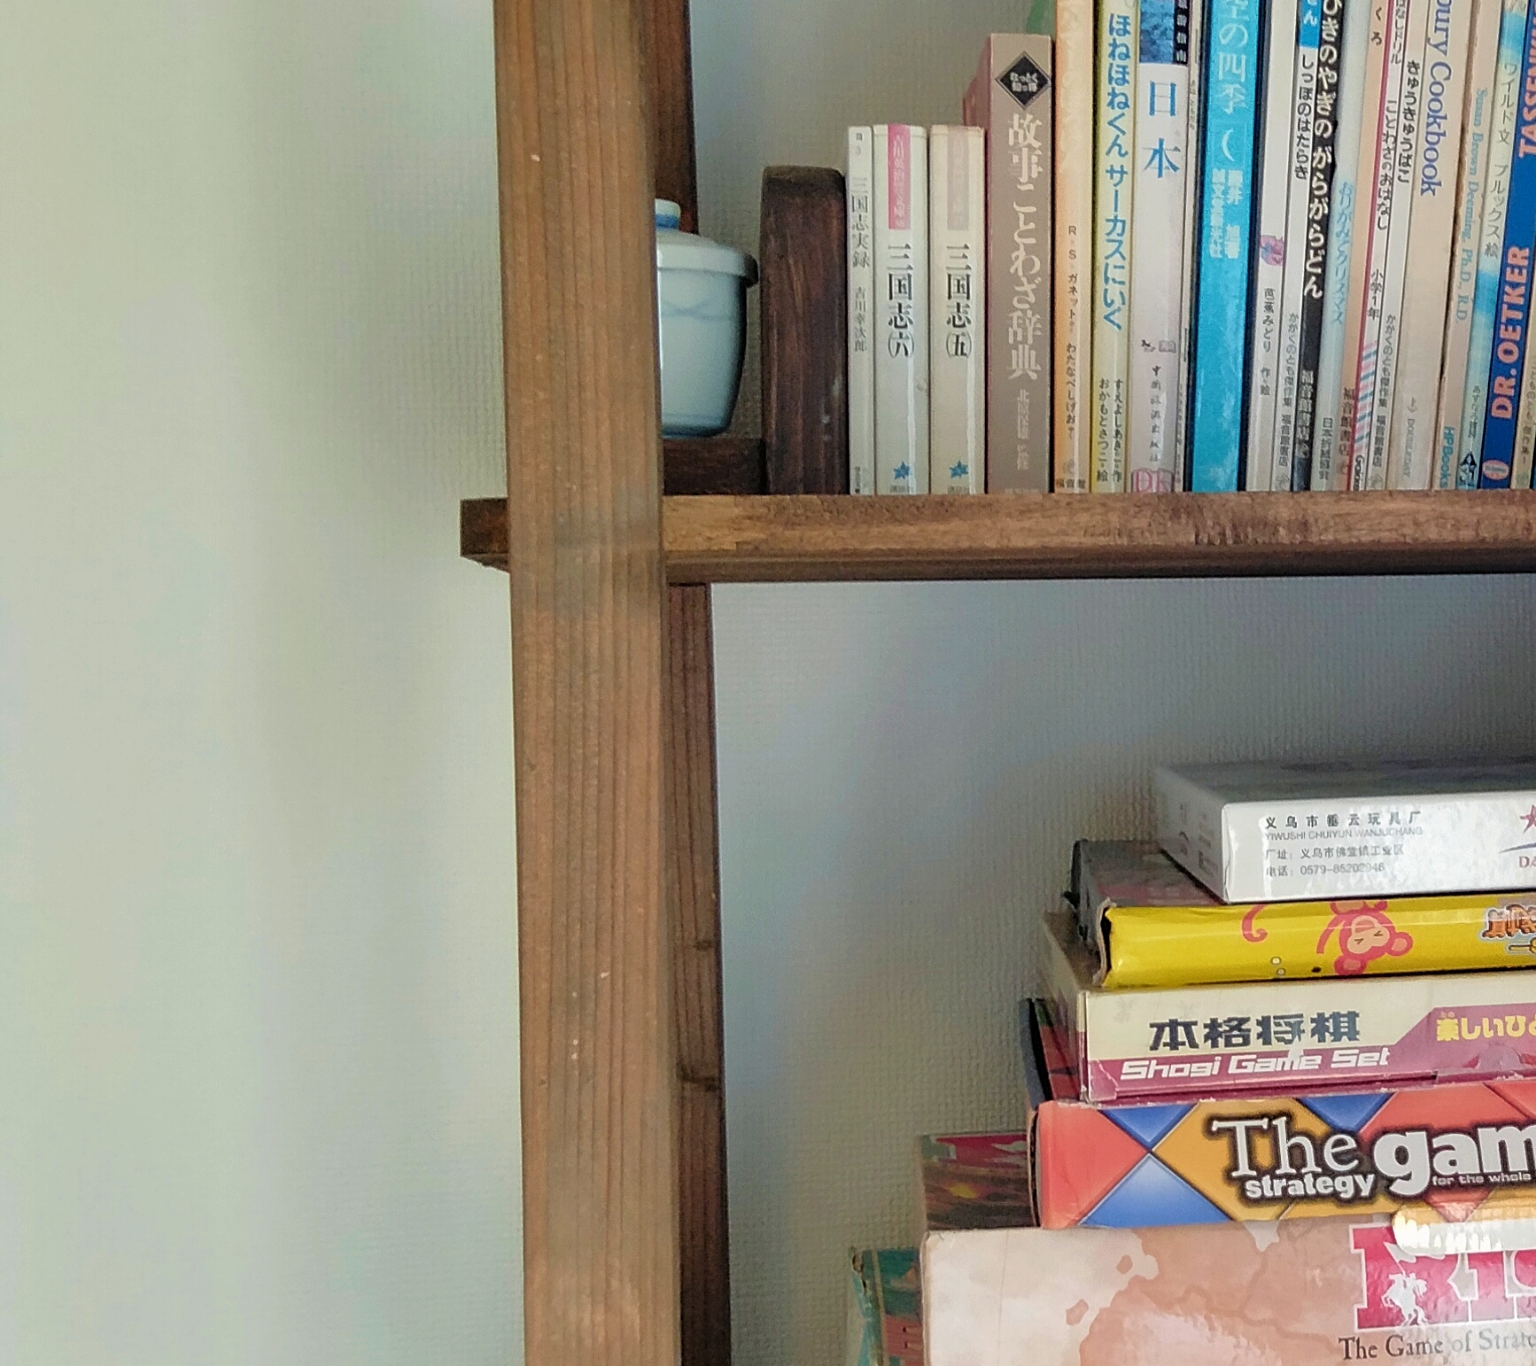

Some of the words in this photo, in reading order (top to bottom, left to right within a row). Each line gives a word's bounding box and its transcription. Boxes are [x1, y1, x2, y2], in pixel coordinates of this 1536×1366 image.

[1105, 13, 1132, 158] ほねほねくん
[1142, 81, 1181, 178] 日本
[1294, 54, 1314, 180] しっぽのはたらき
[1398, 60, 1421, 184] きゅうきゅうばこ
[1420, 61, 1452, 197] Cookbook
[1376, 99, 1398, 230] ことわざのおはなし
[1469, 132, 1484, 176] Brown
[851, 176, 870, 268] 三国志実録
[1007, 113, 1043, 380] 故事ことわざ辞典
[1102, 165, 1129, 330] サーカスにいく
[1303, 146, 1333, 298] がらがらどん
[1367, 268, 1384, 321] 小学1年
[1496, 246, 1530, 364] OETKER
[1491, 368, 1518, 419] DR.
[1265, 830, 1307, 841] YIWUSHI
[1307, 828, 1353, 841] CHUIYUN
[1354, 826, 1424, 838] WANJUCHANG
[1120, 1055, 1222, 1081] Shogi
[1227, 1050, 1320, 1075] Game
[1329, 1046, 1391, 1069] Set
[1148, 1009, 1361, 1052] 本格将棋
[1210, 1115, 1361, 1178] The
[1244, 1172, 1376, 1200] strategy
[1431, 1174, 1453, 1186] for
[1455, 1173, 1484, 1184] the
[1486, 1171, 1533, 1184] whole
[1338, 1337, 1379, 1361] The
[1384, 1332, 1444, 1358] Game
[1451, 1330, 1472, 1353] of
